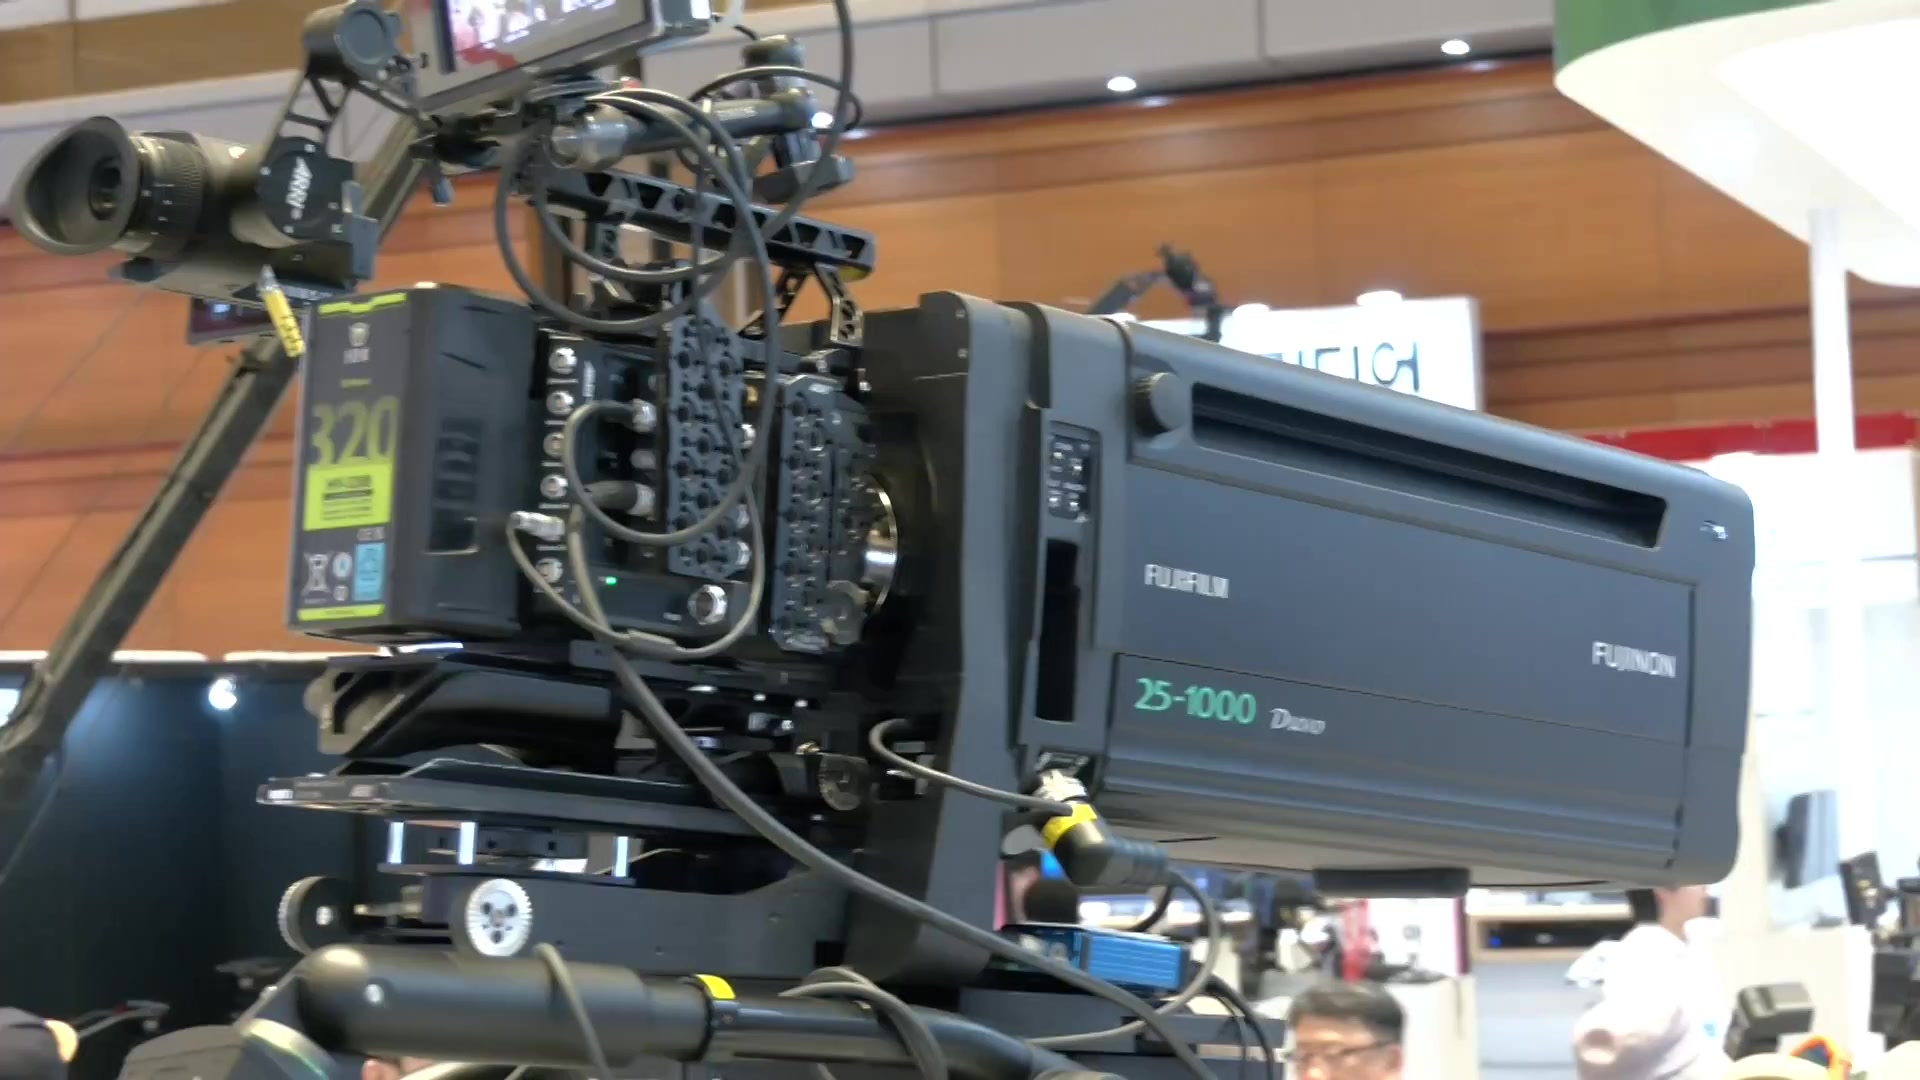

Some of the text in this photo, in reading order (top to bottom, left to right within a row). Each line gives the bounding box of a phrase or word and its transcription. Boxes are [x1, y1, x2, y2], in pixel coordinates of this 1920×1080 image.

[285, 156, 313, 209] ARRI
[311, 396, 398, 466] 320
[1591, 641, 1677, 679] FUJINON
[1133, 677, 1257, 724] 25-1000
